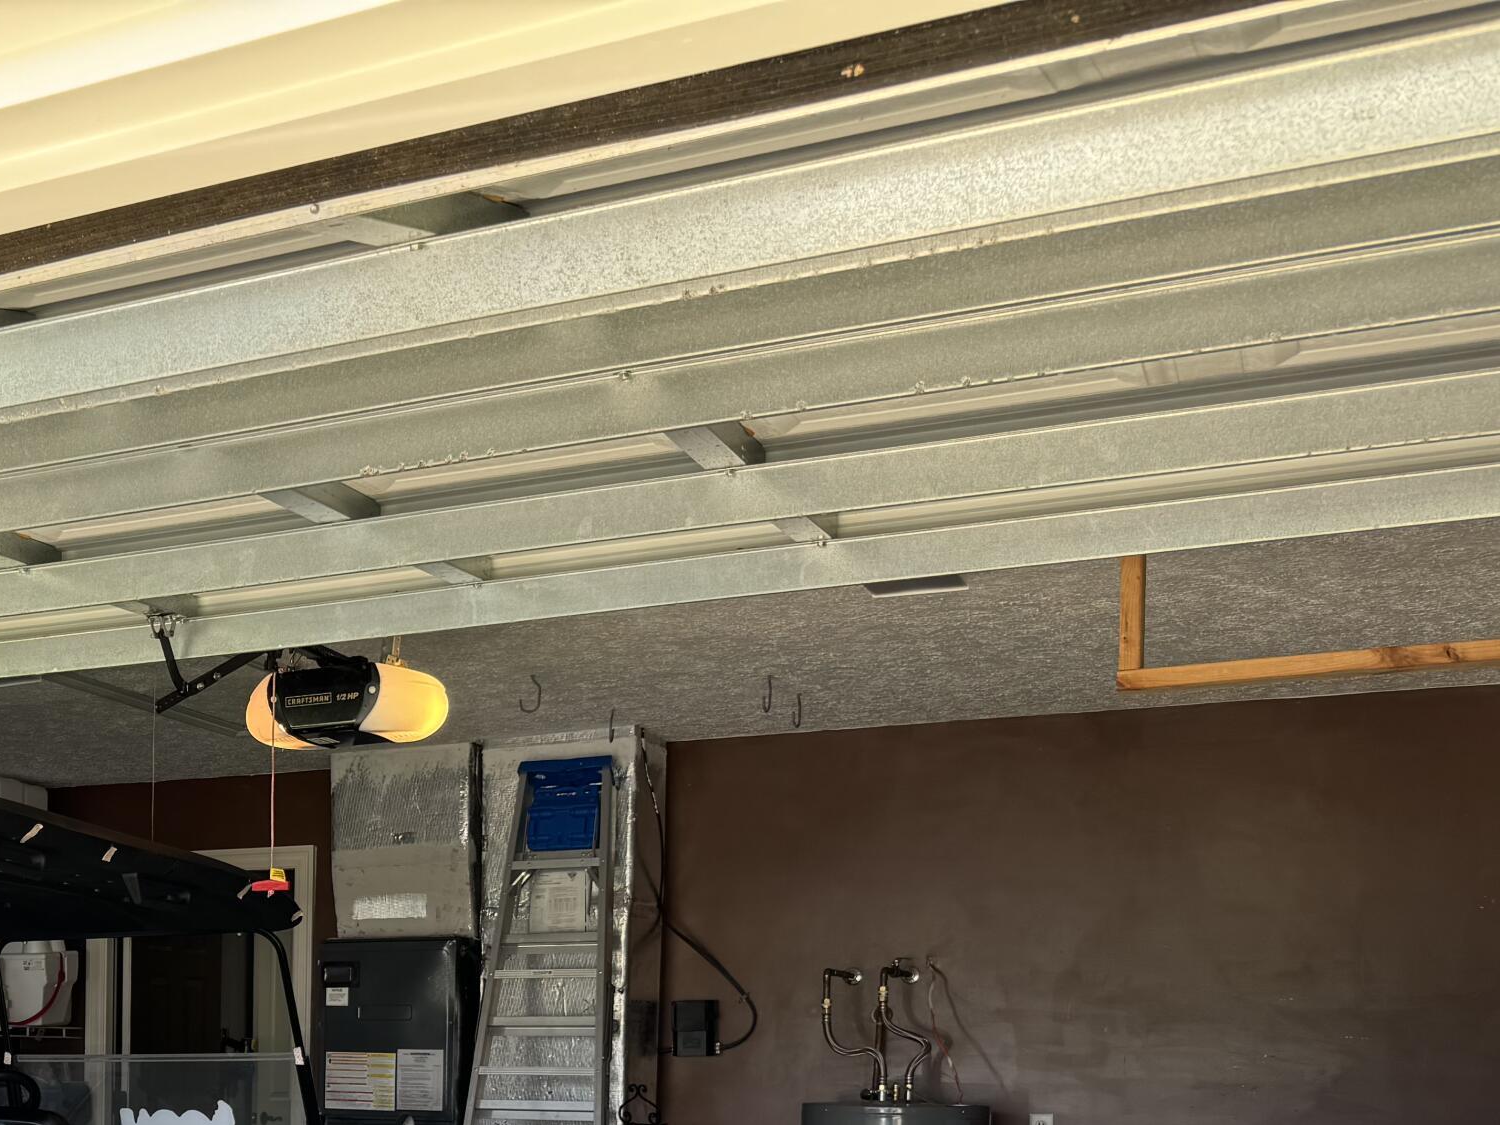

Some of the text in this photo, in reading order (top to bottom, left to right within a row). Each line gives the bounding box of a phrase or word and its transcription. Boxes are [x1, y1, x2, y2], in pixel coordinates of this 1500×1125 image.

[287, 692, 359, 706] CRAFTSMAN 1/2 HP
